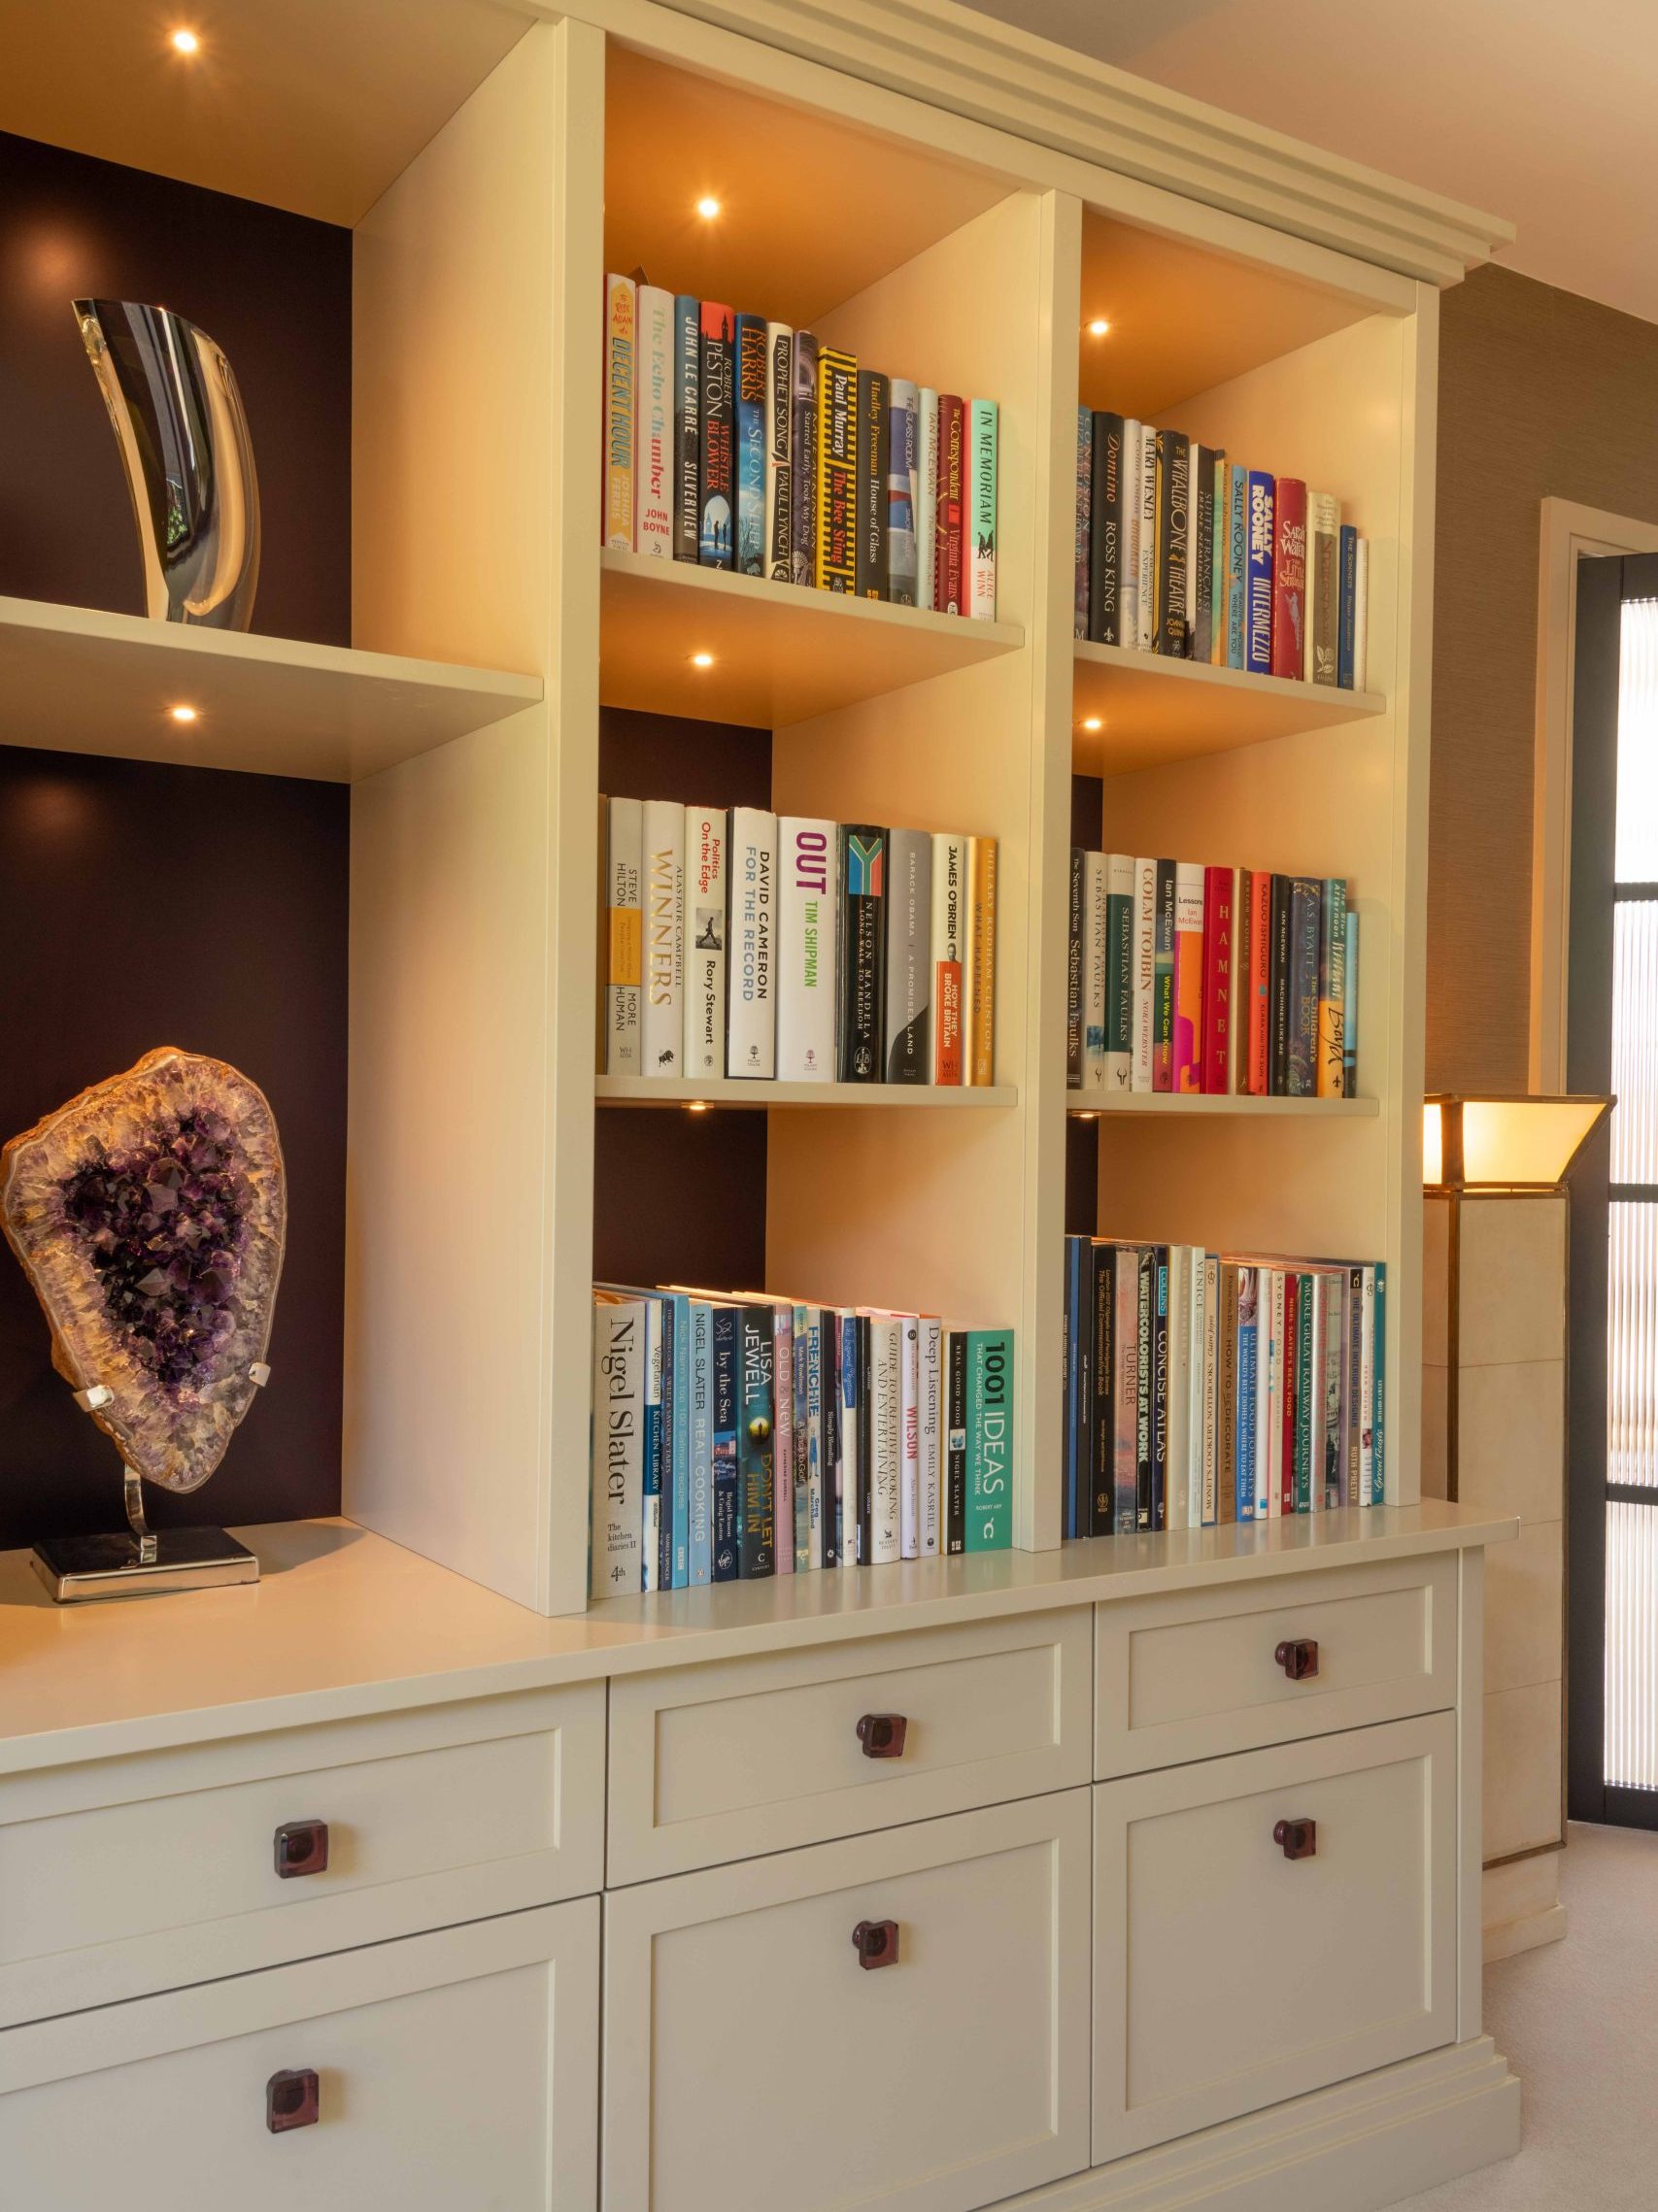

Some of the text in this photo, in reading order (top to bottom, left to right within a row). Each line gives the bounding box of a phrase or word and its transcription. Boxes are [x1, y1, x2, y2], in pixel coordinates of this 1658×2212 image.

[707, 341, 722, 418] PESTON
[741, 326, 756, 401] HARRIS
[757, 332, 765, 401] ROBERT
[612, 337, 631, 469] DECENT HOUR
[651, 308, 664, 499] The Echo Chamber
[684, 317, 698, 540] JOHN LE CARRÉ SILVERVIEW
[706, 419, 719, 489] BLOWER
[720, 424, 729, 493] WHISTLE
[776, 339, 789, 555] PROPHET SONG PAUL LYNCH
[802, 449, 811, 474] Early,
[831, 374, 847, 563] Paul Murray The Bee Sting
[868, 381, 880, 563] Hadley Freeman House of Glass
[980, 411, 993, 523] IN MEMORIAM
[1144, 436, 1155, 521] MARY WESLEY
[643, 522, 669, 536] BOYNE
[645, 509, 667, 521] JOHN
[801, 525, 810, 546] Dog
[802, 506, 810, 521] My
[1104, 433, 1120, 612] Domino ROSS KING
[1168, 459, 1186, 614] WHALEBONE THEATRE
[1234, 481, 1243, 584] SALLY ROONEY
[1251, 485, 1264, 565] ROONEY
[1251, 577, 1270, 663] INTERMEZZO
[617, 863, 626, 907] HILTON
[699, 822, 710, 893] On the Edge
[948, 846, 957, 887] JAMES
[1165, 879, 1173, 898] Ian
[650, 849, 673, 1007] WINNERS
[743, 847, 757, 1001] FOR THE RECORD
[758, 851, 769, 1000] DAVID CAMERON
[796, 832, 827, 988] OUT TIM SHIPMAN
[1164, 901, 1173, 951] McEwan
[705, 960, 716, 1044] Rory Stewart
[1068, 940, 1080, 1009] Sebastian
[1120, 907, 1130, 1041] SEBASTIAN FAULKS
[616, 987, 625, 1031] HUMAN
[627, 993, 636, 1026] MORE
[1068, 1012, 1079, 1057] Faulks
[1163, 1002, 1169, 1016] We
[719, 1351, 729, 1370] by
[745, 1324, 760, 1405] JEWELL
[761, 1341, 771, 1386] LISA
[808, 1326, 820, 1418] FRENCHIE
[888, 1332, 897, 1374] GUIDE
[928, 1326, 939, 1363] Deep
[1126, 1343, 1136, 1405] TURNER
[1139, 1271, 1149, 1462] WATERCOLORISTS AT WORK
[1303, 1324, 1311, 1362] GREAT
[601, 1319, 635, 1504] Nigel Slater
[720, 1374, 731, 1398] the
[720, 1401, 728, 1424] Sea
[889, 1379, 897, 1393] TO
[925, 1369, 939, 1434] Listening
[983, 1342, 1005, 1494] 1001 IDEAS
[1302, 1368, 1310, 1419] RAILWAY
[694, 1313, 705, 1542] NIGEL SLATER REAL COOKING
[877, 1359, 887, 1495] AND ENTERTAINING
[888, 1396, 897, 1458] CREATIVE
[907, 1406, 917, 1460] WILSON
[974, 1453, 981, 1466] WE
[1301, 1423, 1309, 1489] JOURNEYS
[747, 1473, 760, 1533] HIM IN
[608, 1543, 629, 1552] diaries
[611, 1565, 626, 1582] 4th
